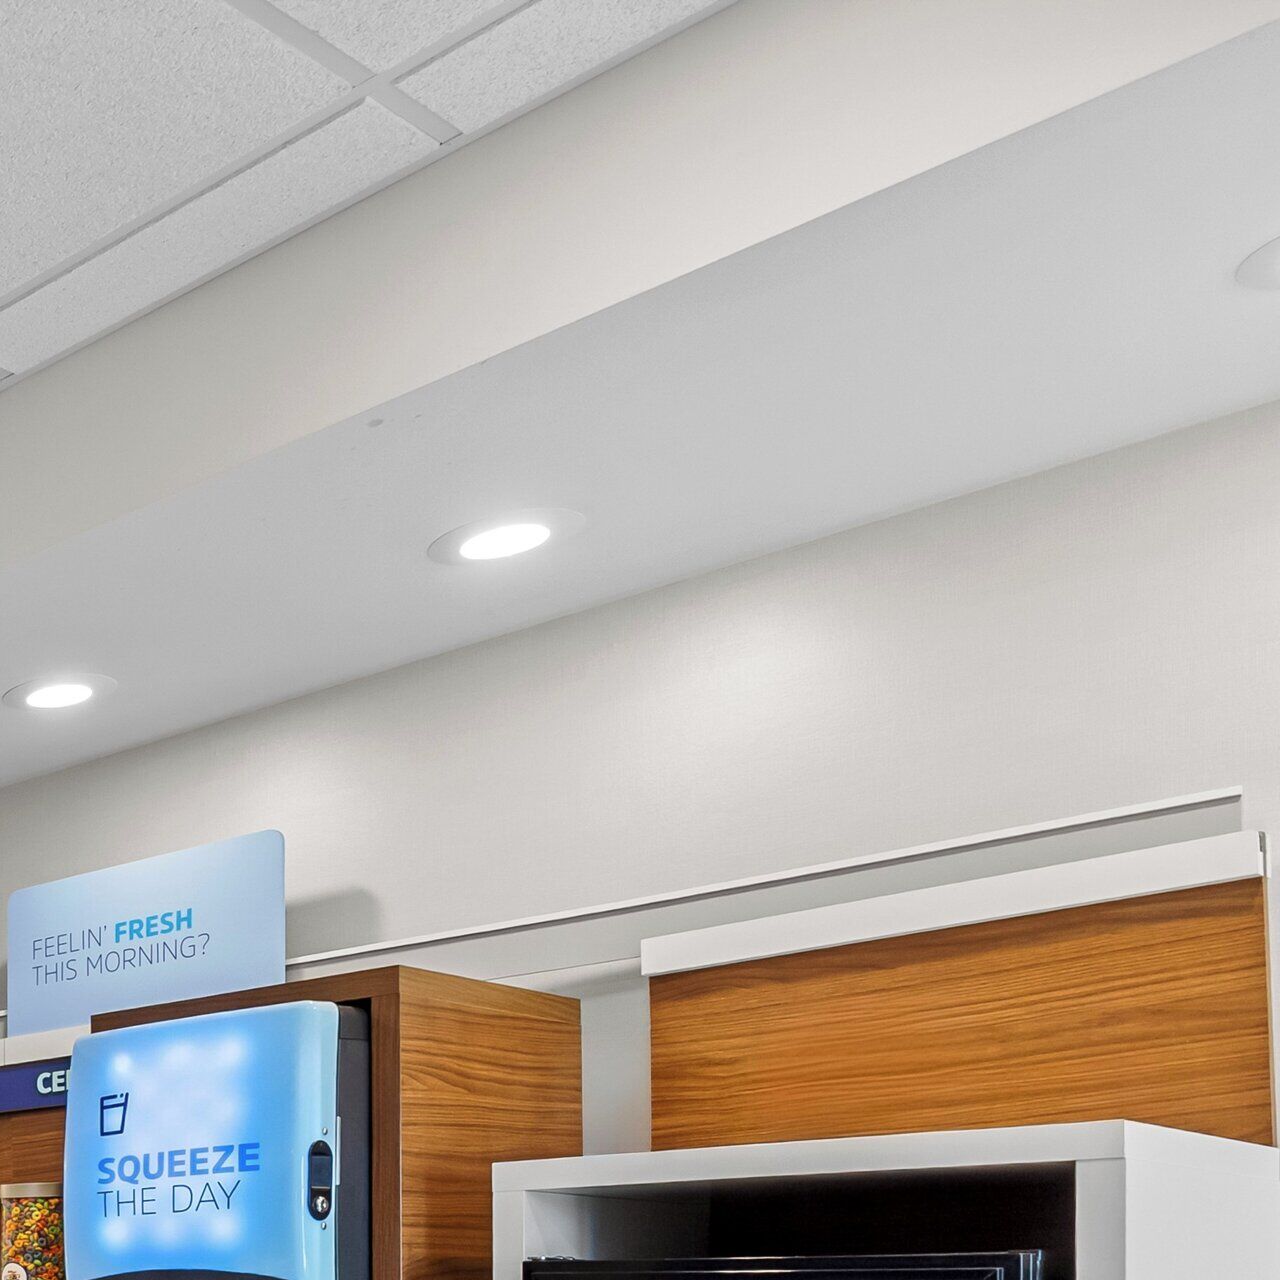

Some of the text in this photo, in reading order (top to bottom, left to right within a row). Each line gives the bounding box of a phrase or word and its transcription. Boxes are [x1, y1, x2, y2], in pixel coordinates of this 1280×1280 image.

[114, 908, 193, 944] FRESH
[32, 933, 210, 986] THIS MORNING?
[96, 1142, 261, 1185] SQUEEZE
[97, 1180, 241, 1219] THE DAY
